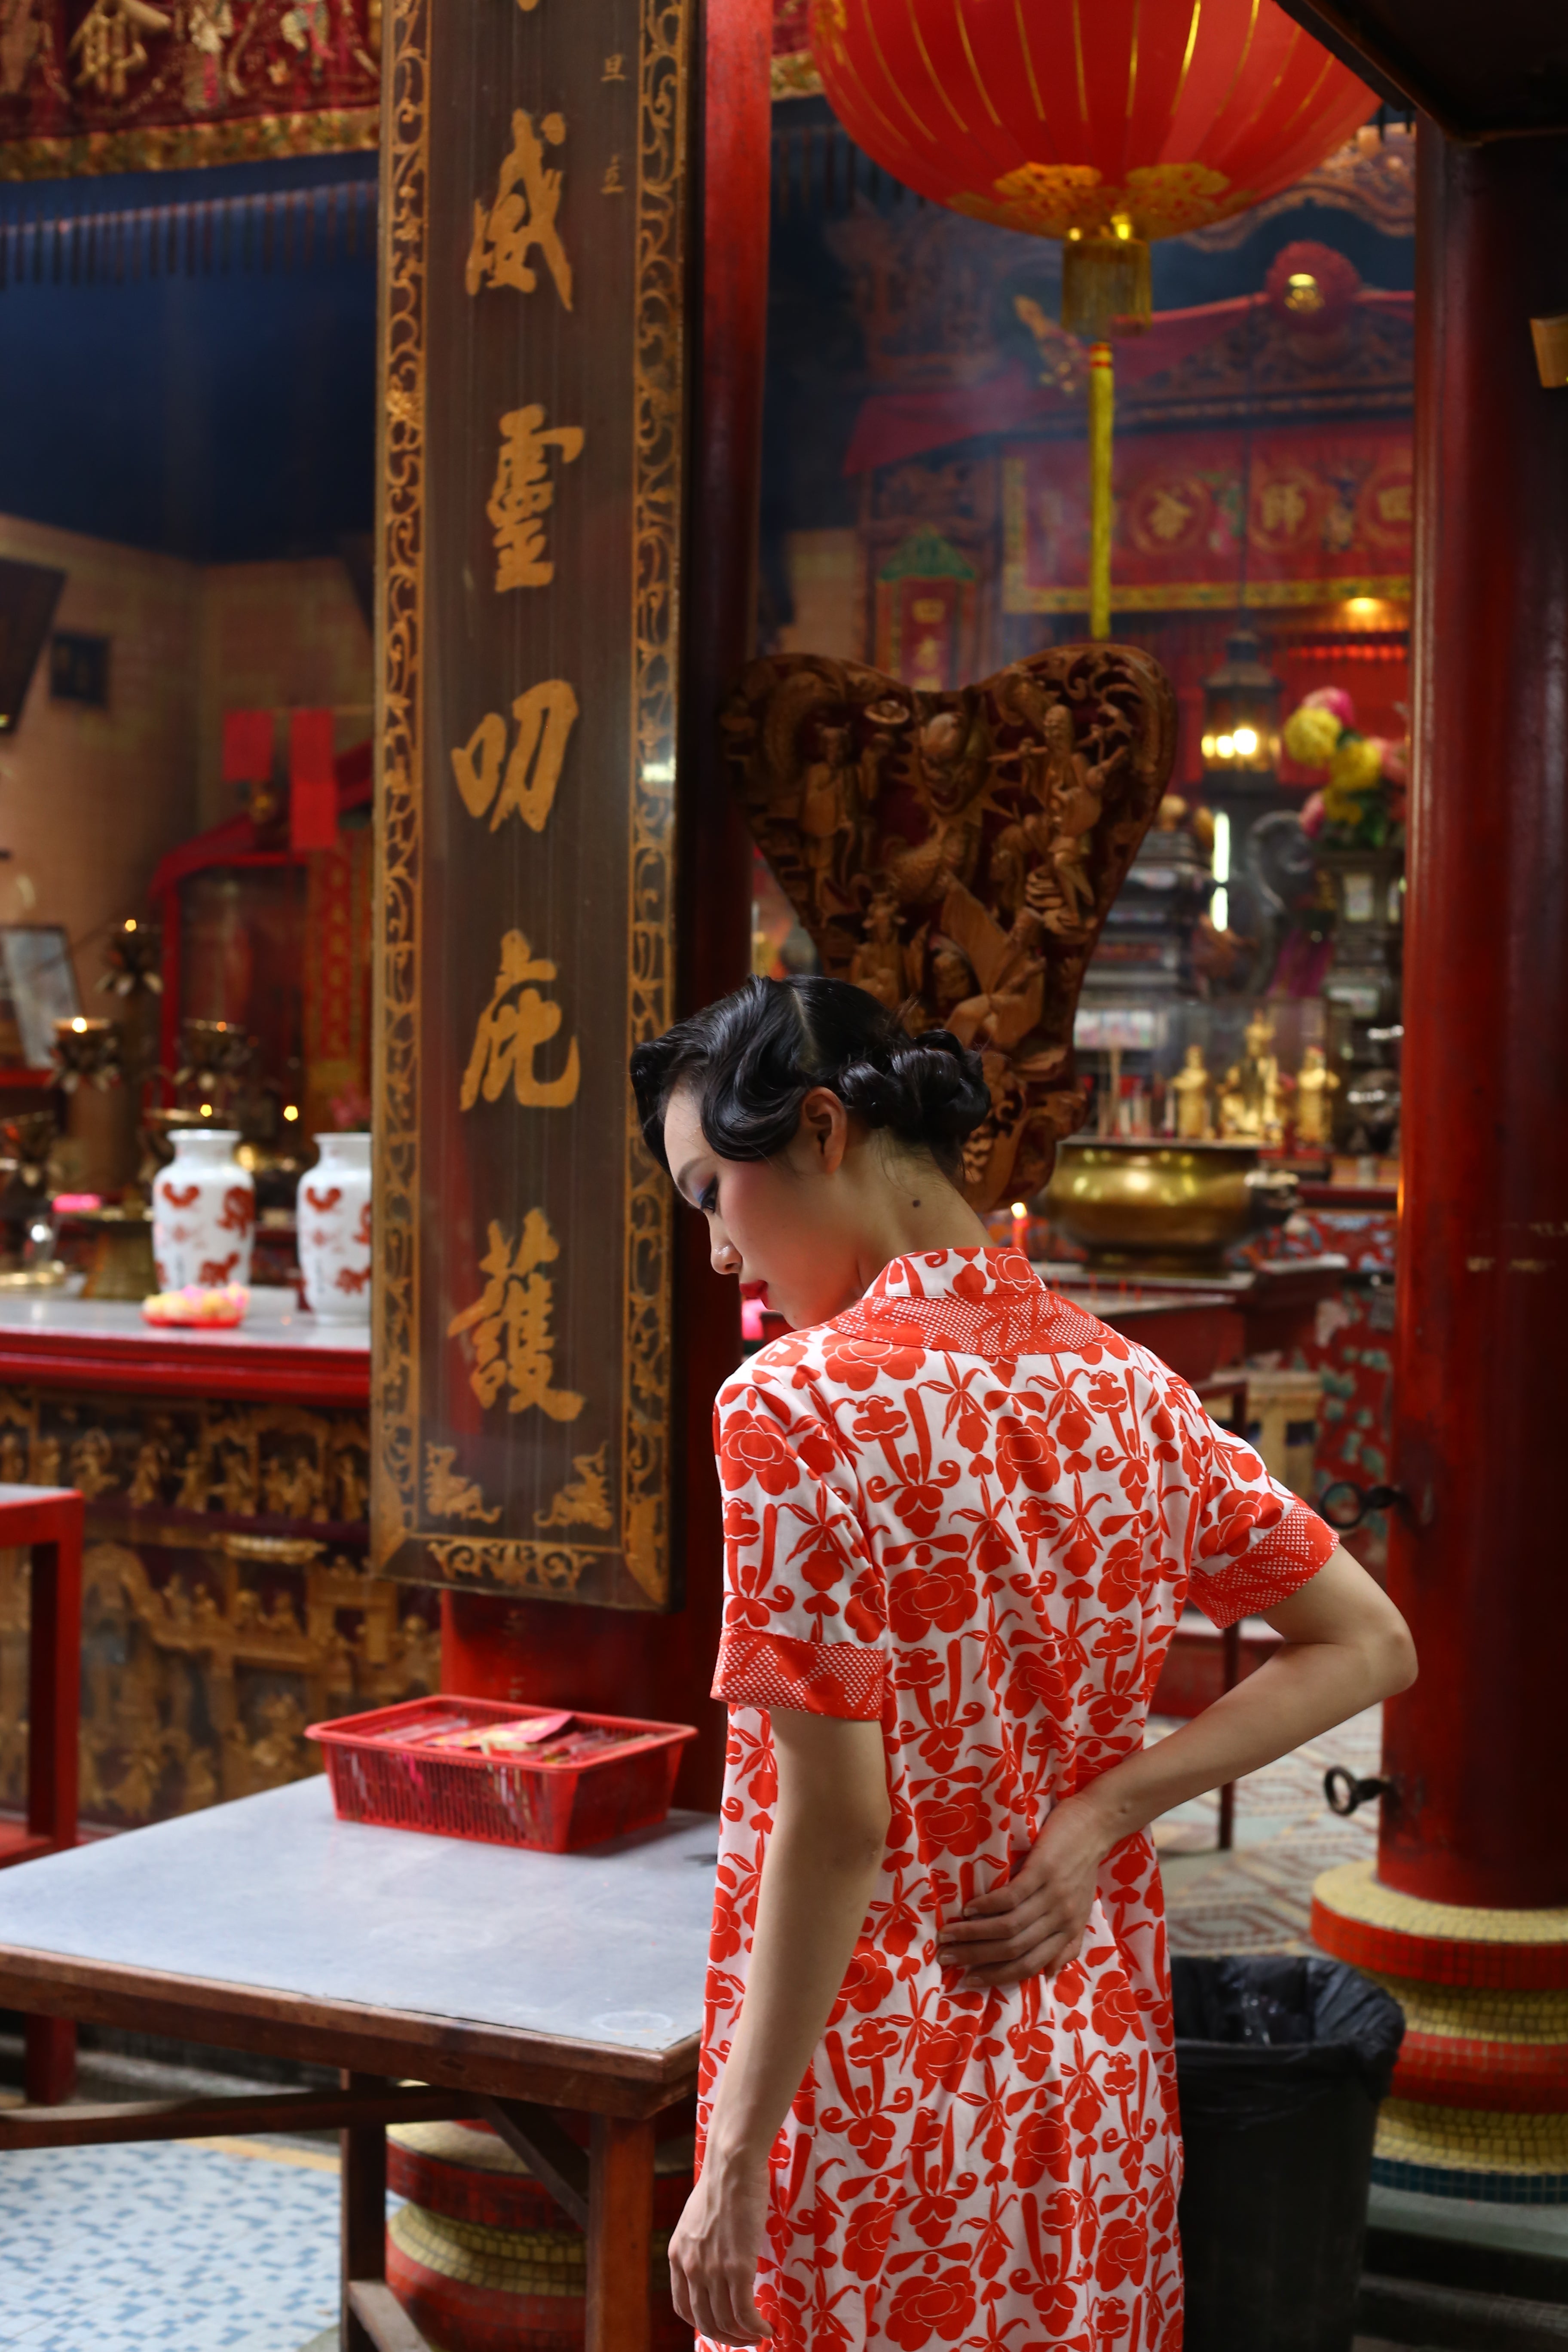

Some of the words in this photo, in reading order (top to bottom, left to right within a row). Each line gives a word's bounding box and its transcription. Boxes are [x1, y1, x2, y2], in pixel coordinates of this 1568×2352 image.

[447, 0, 585, 1422] 威靈叨庇護
